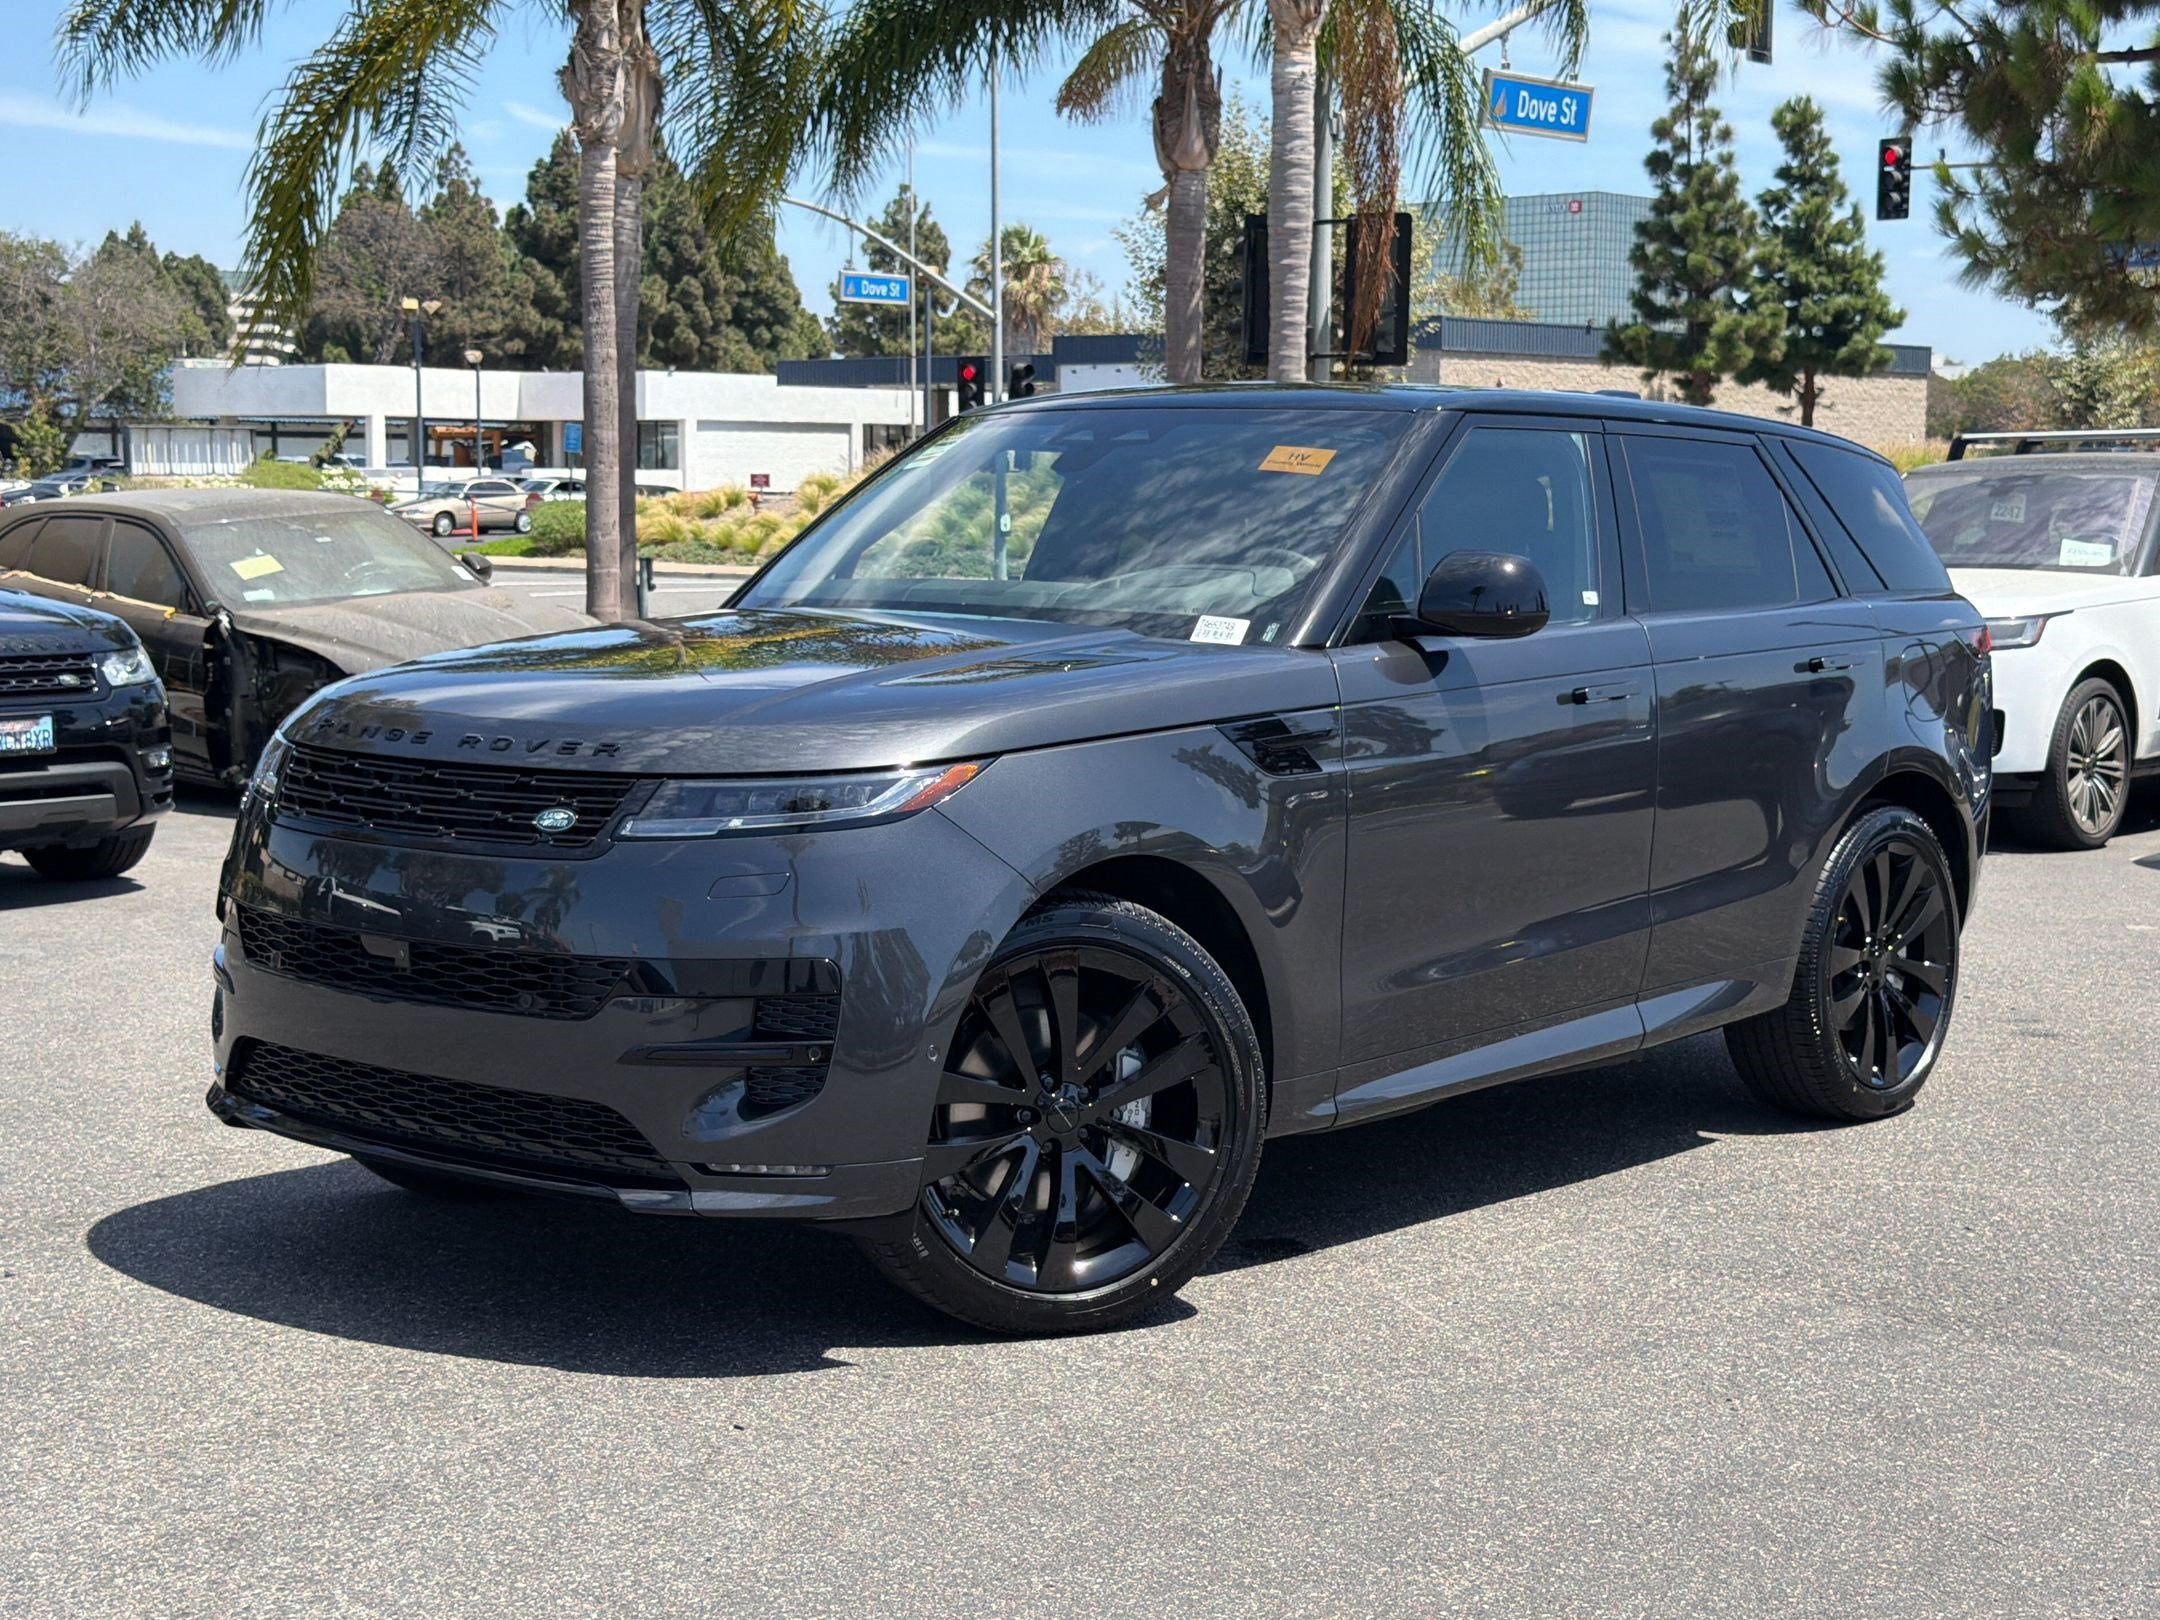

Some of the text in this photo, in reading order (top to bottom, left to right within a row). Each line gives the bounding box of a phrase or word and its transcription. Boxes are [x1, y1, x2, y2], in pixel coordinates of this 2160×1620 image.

[1517, 90, 1577, 126] Dove St
[861, 280, 900, 298] Dove St
[1288, 452, 1312, 462] HV
[317, 717, 622, 758] RANGE ROVER
